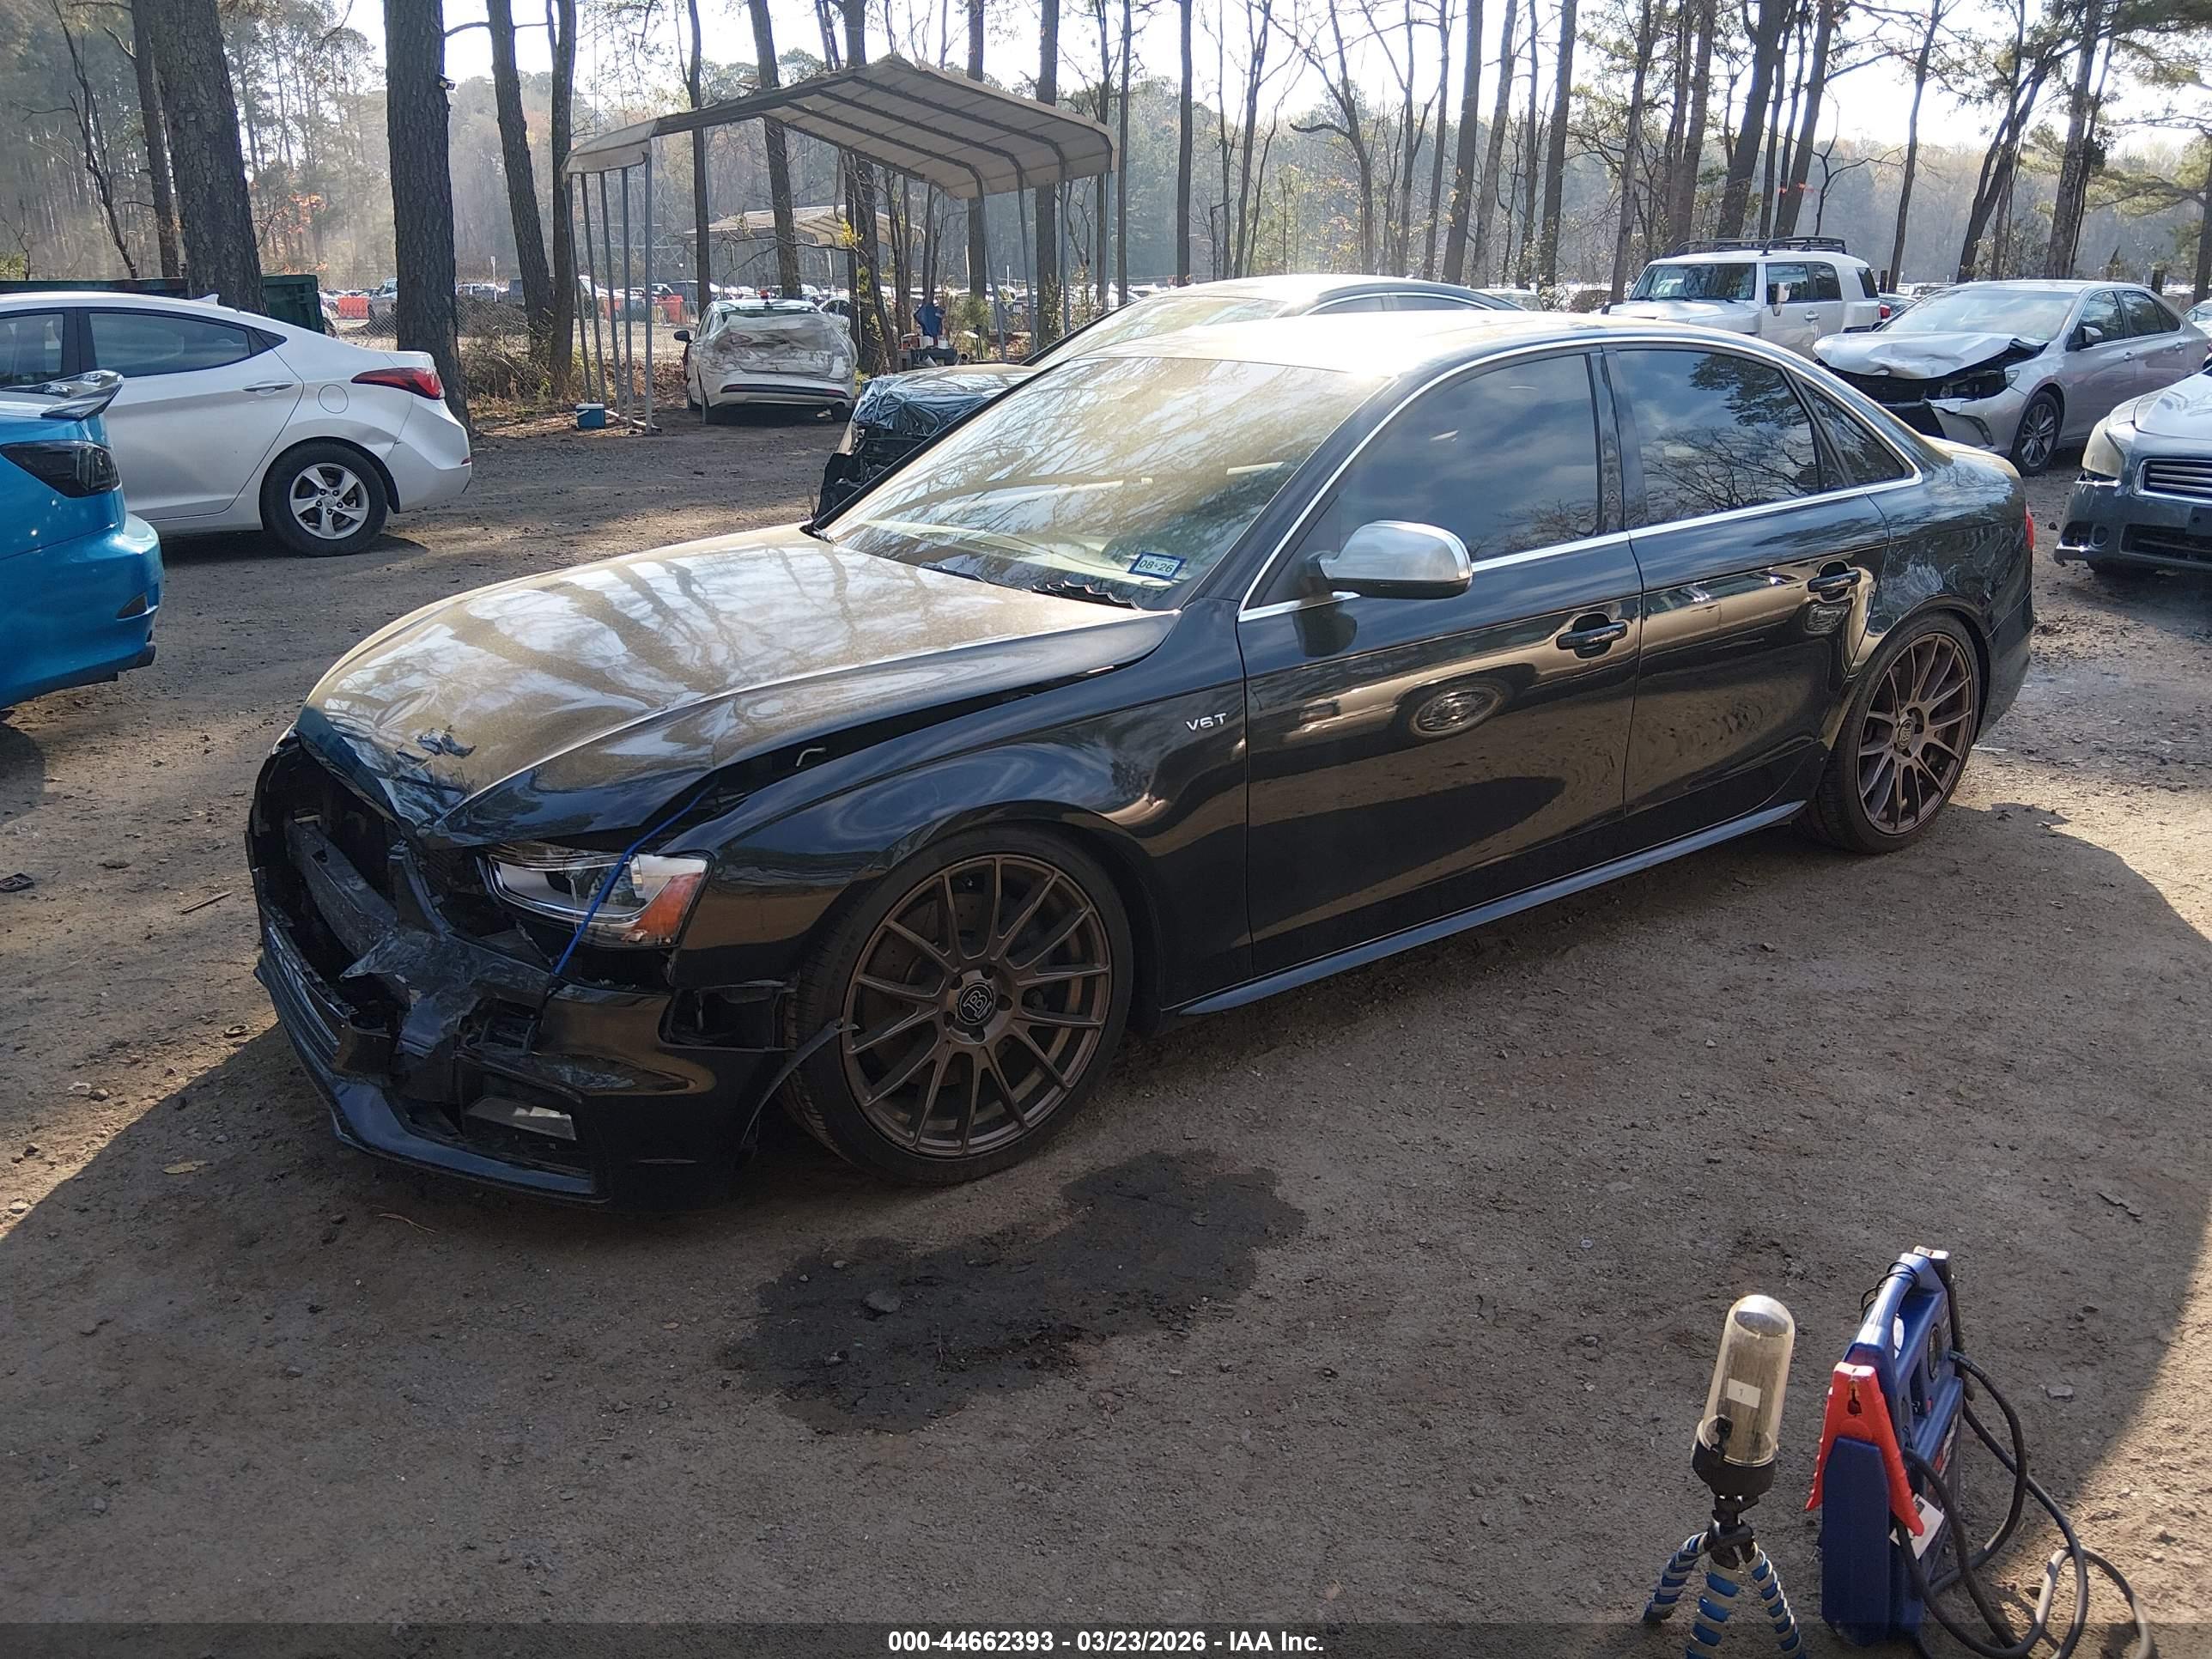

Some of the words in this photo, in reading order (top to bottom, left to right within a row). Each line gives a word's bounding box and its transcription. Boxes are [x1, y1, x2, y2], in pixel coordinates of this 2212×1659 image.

[1139, 559, 1155, 569] 08
[1158, 562, 1175, 573] 26
[1185, 712, 1227, 732] V6T
